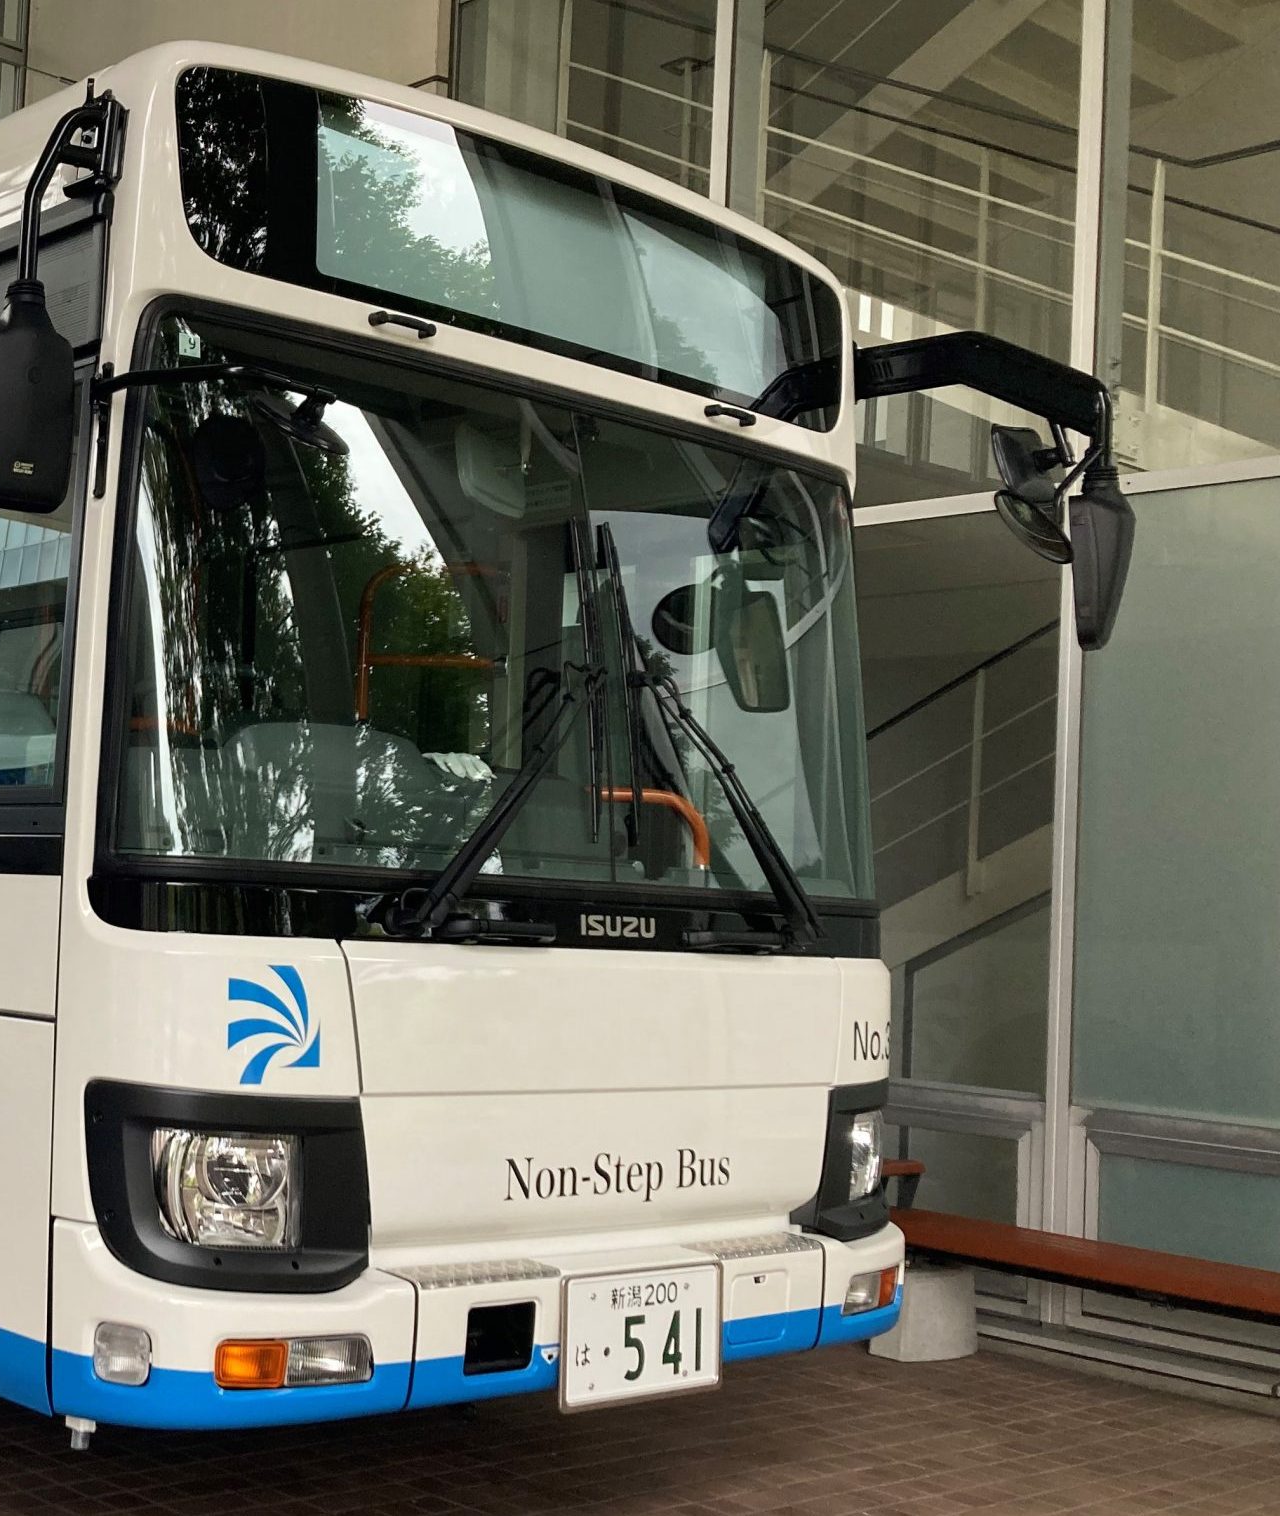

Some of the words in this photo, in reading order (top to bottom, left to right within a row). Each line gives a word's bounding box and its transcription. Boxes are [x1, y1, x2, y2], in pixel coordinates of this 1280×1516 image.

[580, 914, 656, 938] ISUZU
[505, 1151, 663, 1202] Non-Step
[677, 1148, 730, 1188] Bus
